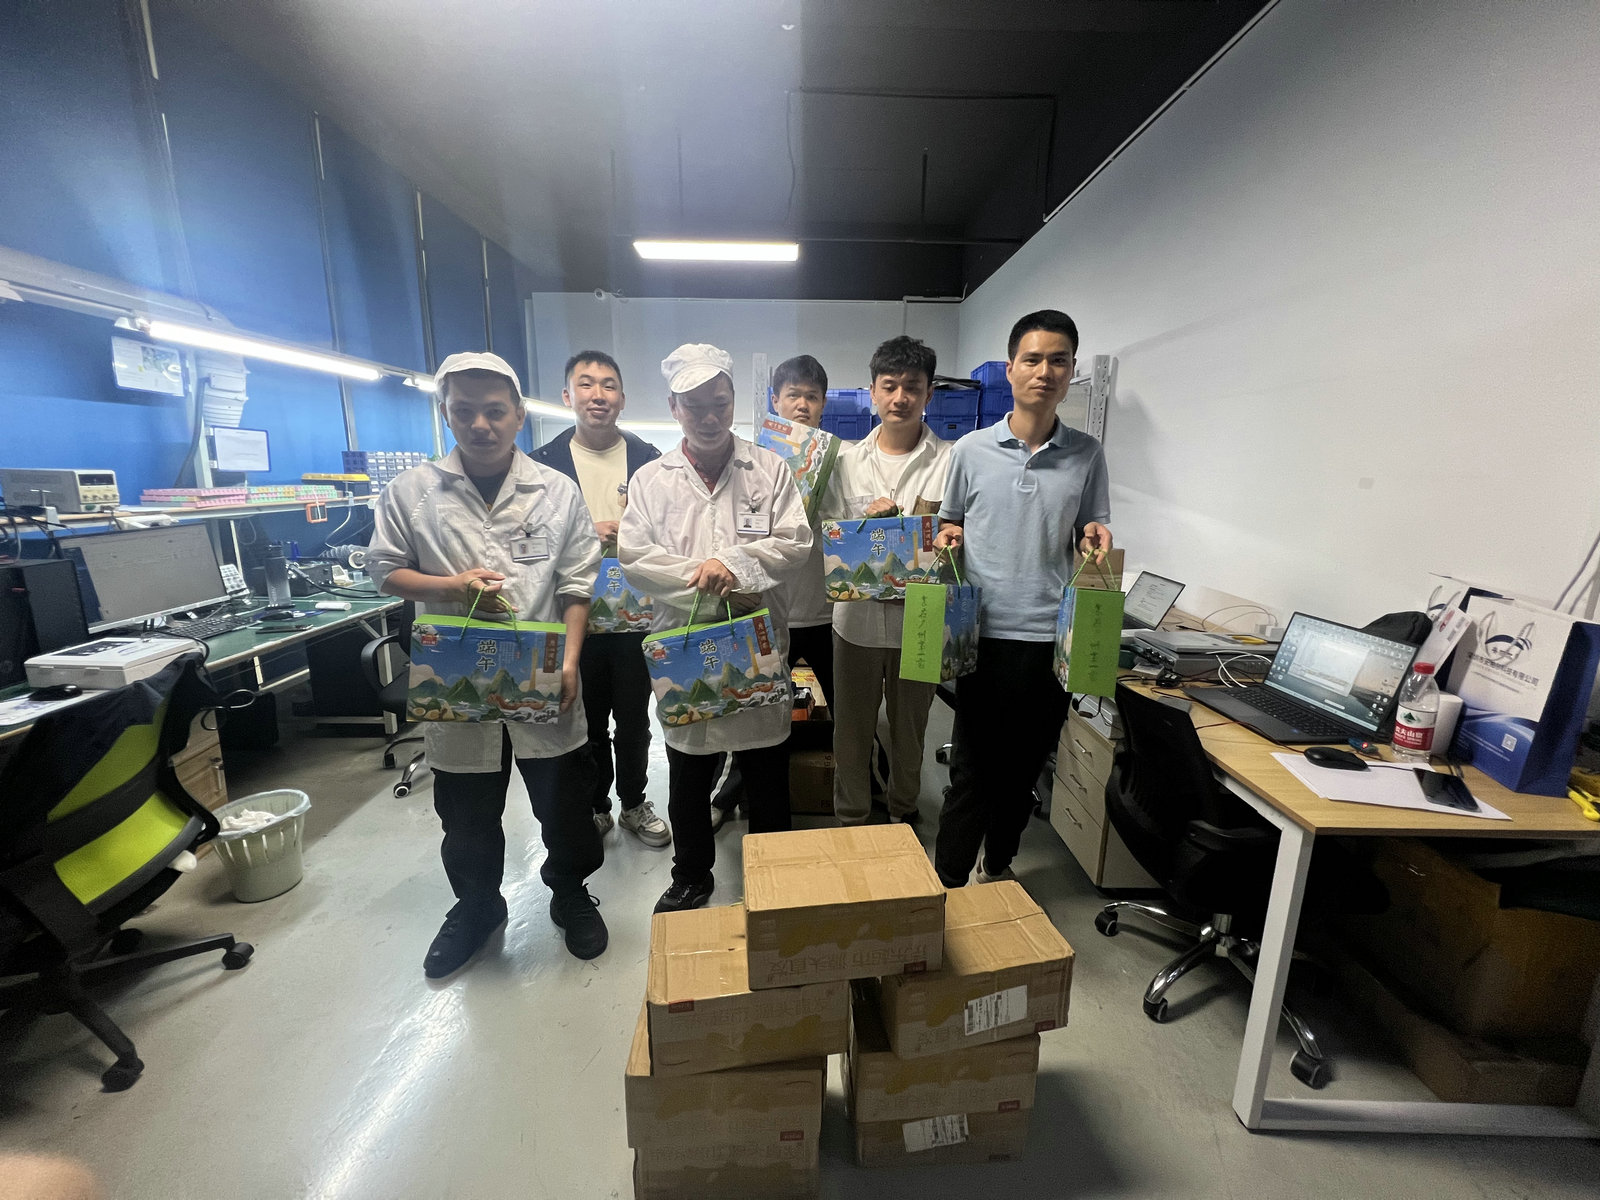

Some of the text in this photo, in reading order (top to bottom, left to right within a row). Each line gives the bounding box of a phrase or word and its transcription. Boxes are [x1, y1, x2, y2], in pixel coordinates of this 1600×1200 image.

[870, 528, 886, 556] 端午
[477, 639, 497, 672] 端午
[699, 638, 720, 670] 端午
